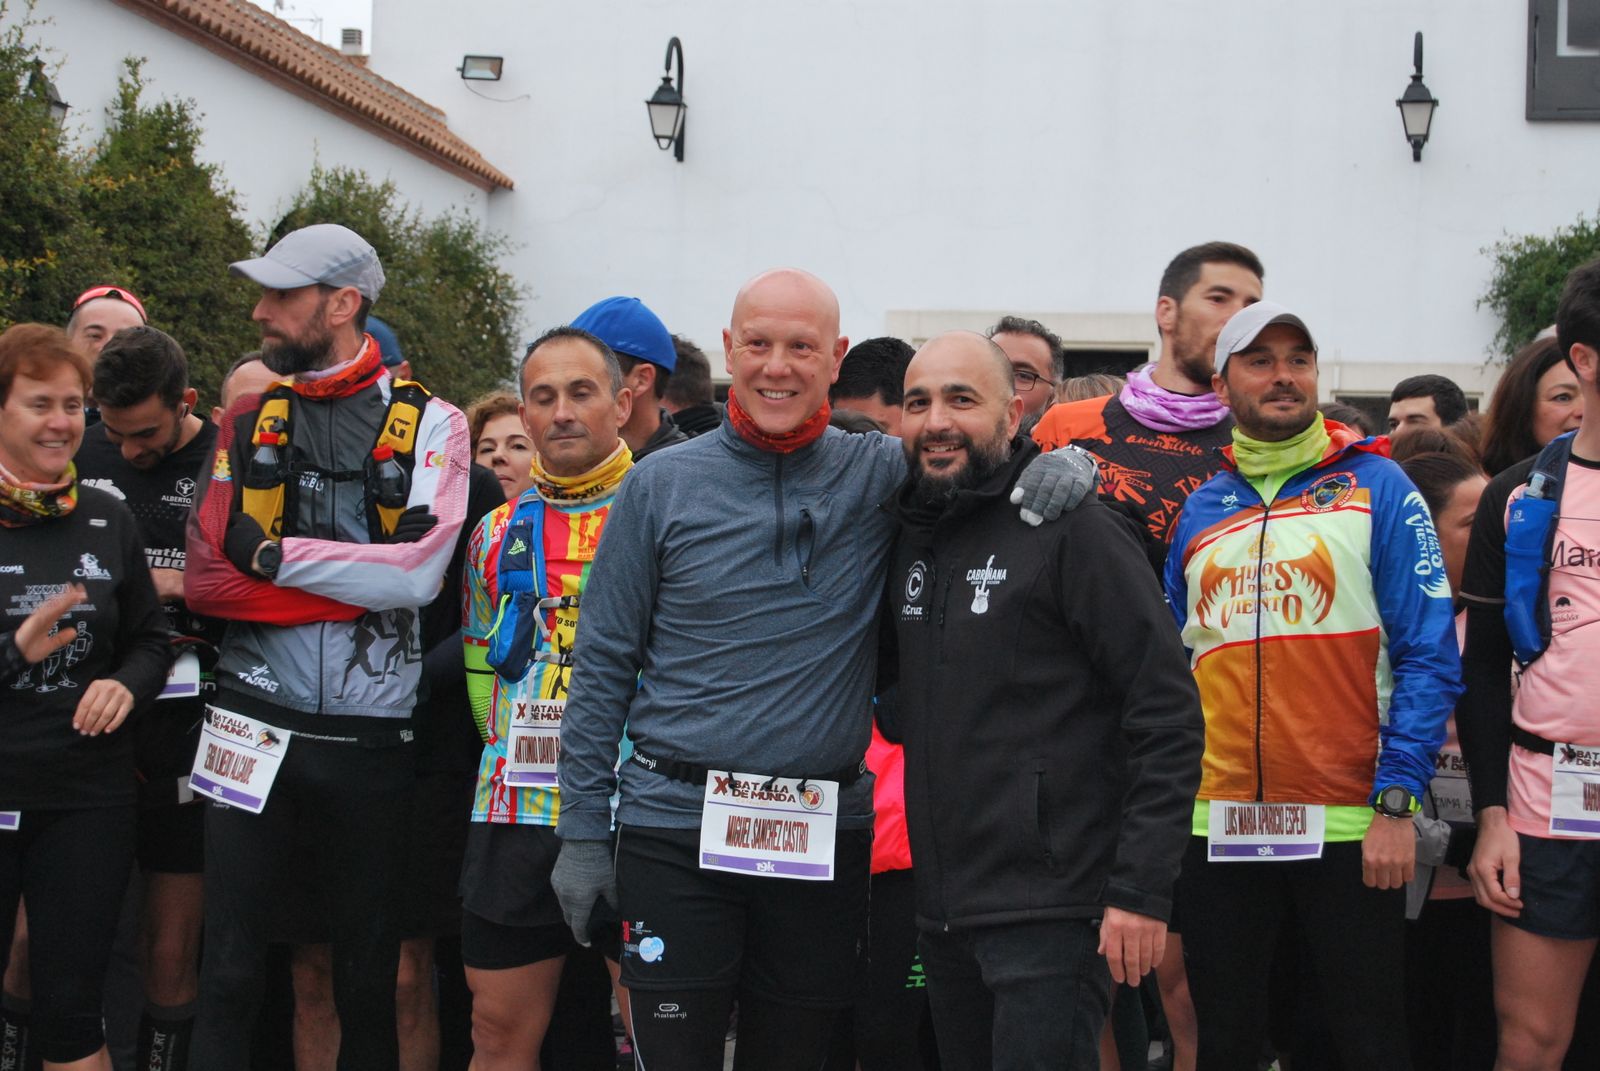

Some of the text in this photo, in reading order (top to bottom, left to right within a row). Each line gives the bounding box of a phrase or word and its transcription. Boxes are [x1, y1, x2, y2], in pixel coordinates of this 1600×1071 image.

[161, 495, 192, 504] ALBERTO
[516, 702, 526, 720] X
[213, 711, 250, 732] BATALLA
[220, 722, 254, 741] MUNDA
[713, 776, 729, 796] X
[731, 789, 749, 799] DE
[750, 790, 797, 803] MUNDA
[1224, 805, 1307, 836] LUIS MARIA APARICIO ESPEJO
[725, 815, 810, 854] MIGUEL SANCHEZ CASTRO
[1257, 845, 1275, 856] 19k
[755, 861, 775, 873] 19k
